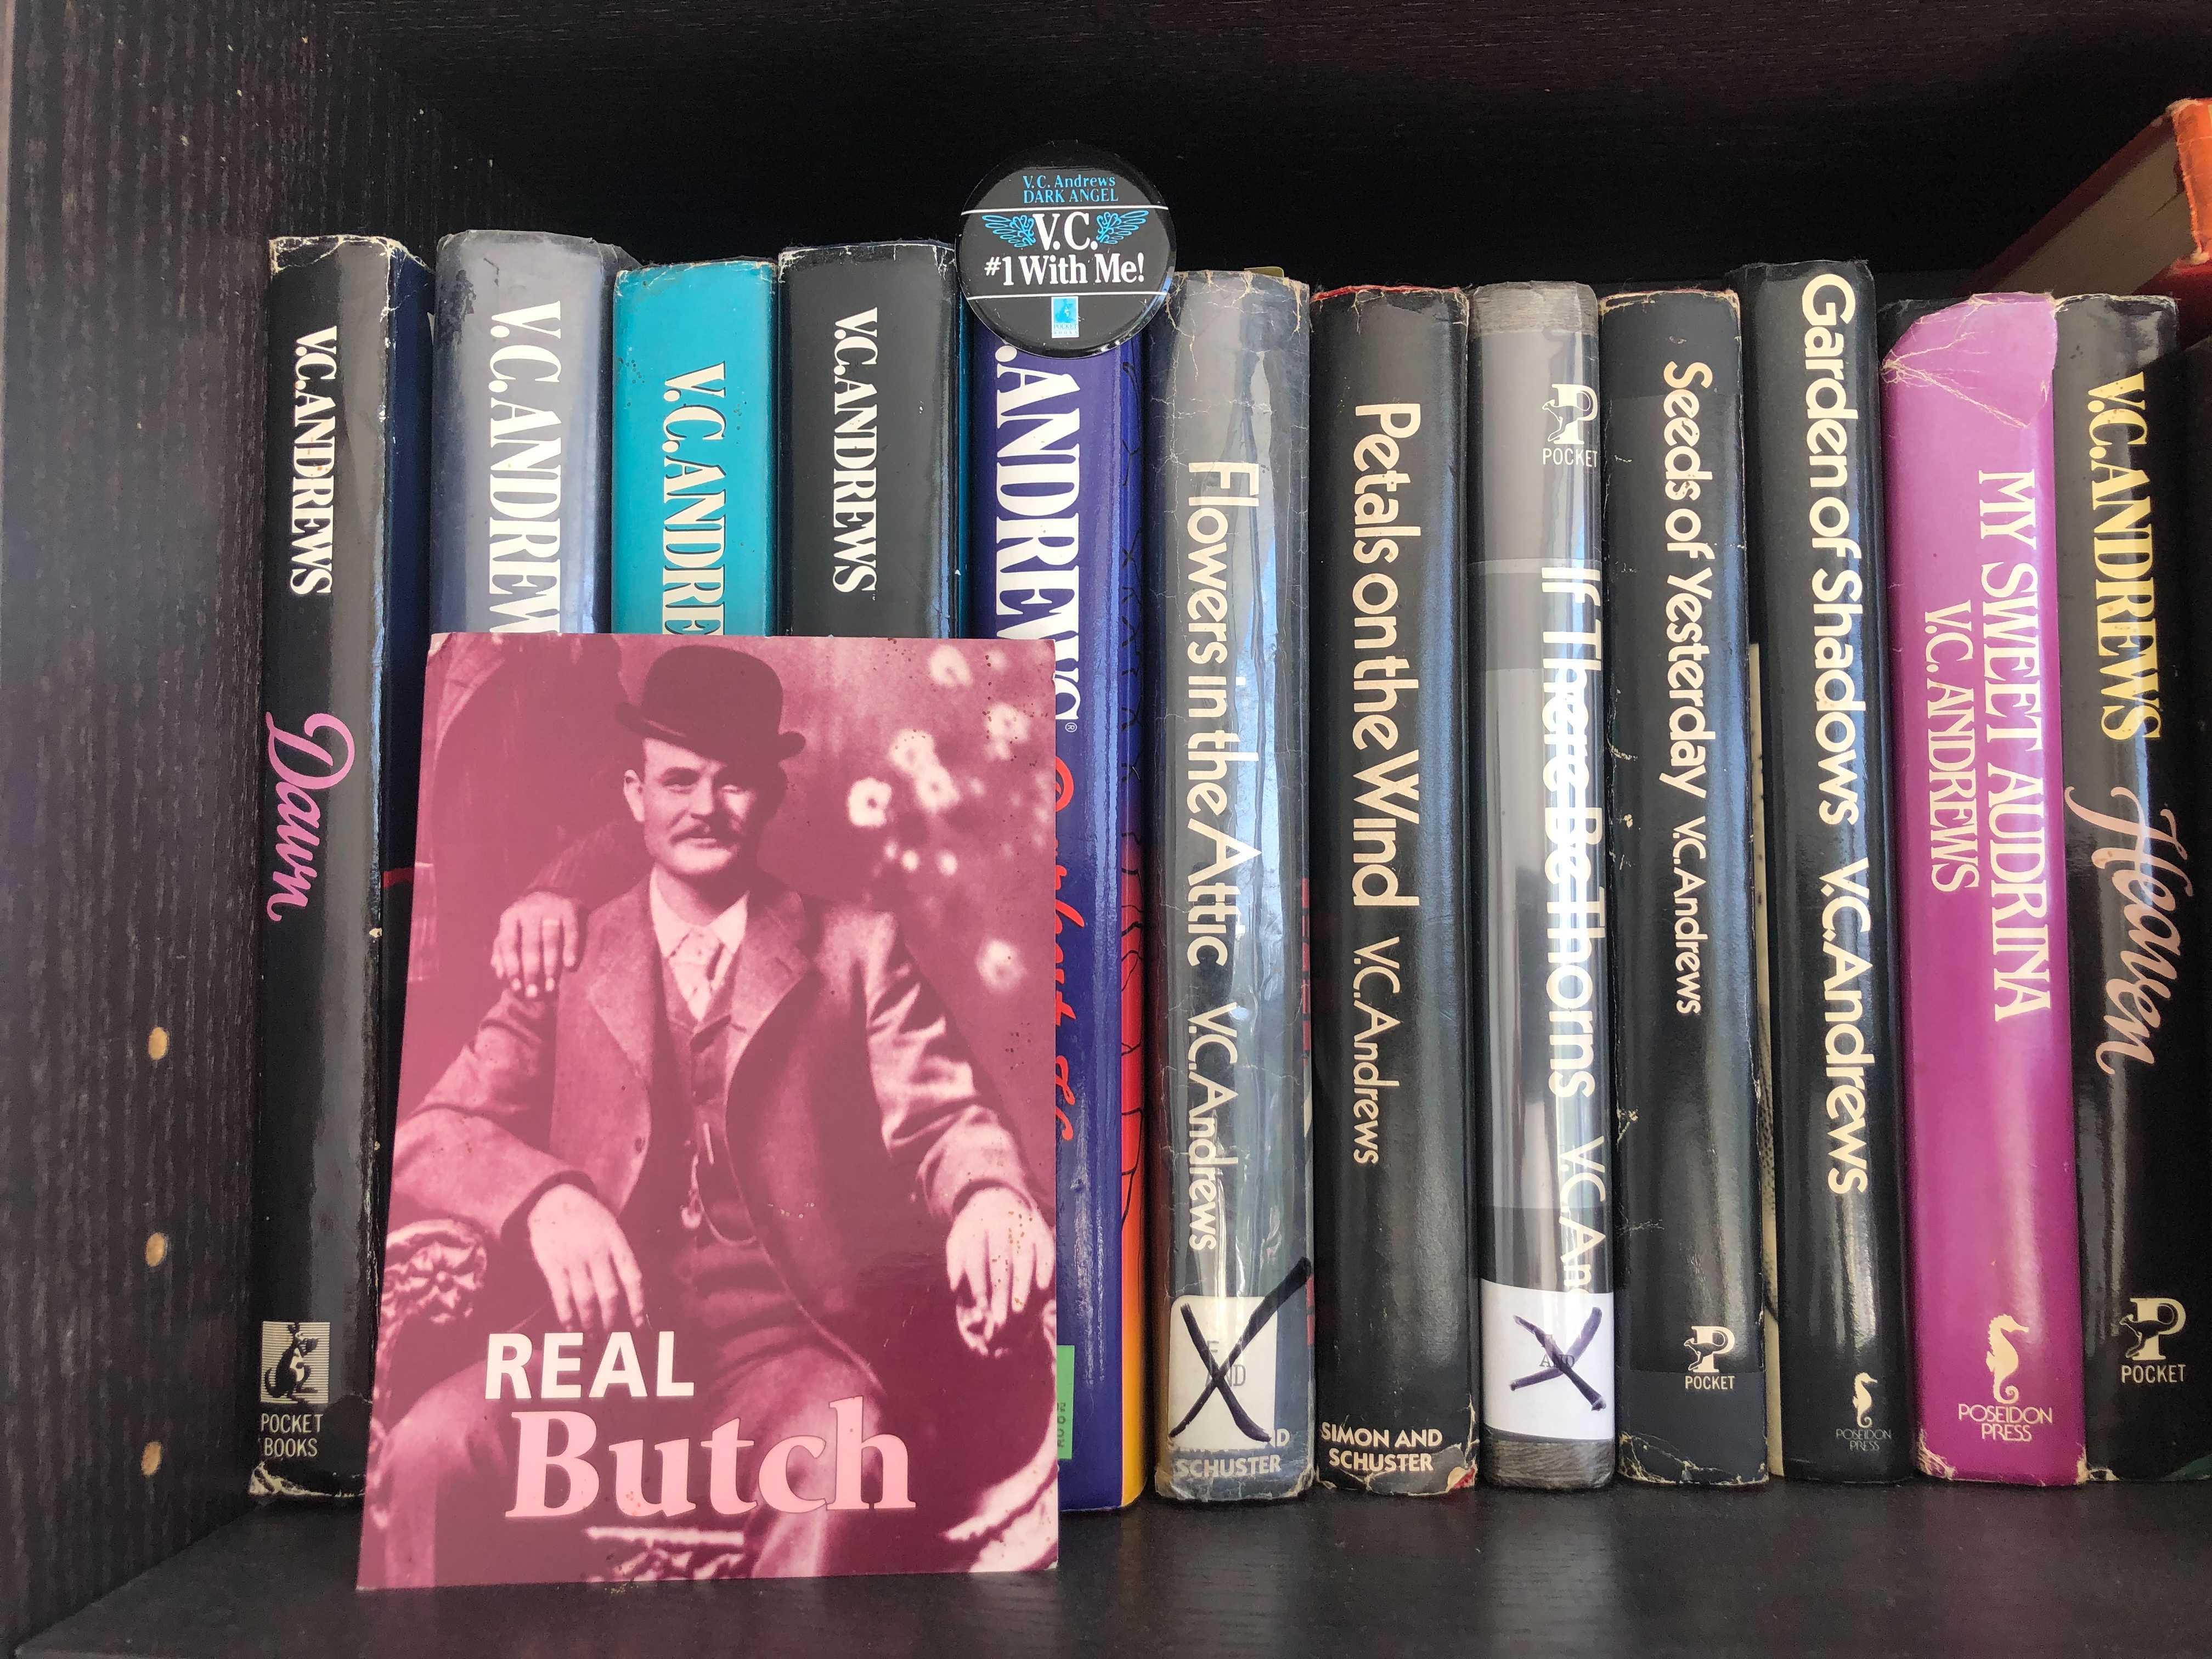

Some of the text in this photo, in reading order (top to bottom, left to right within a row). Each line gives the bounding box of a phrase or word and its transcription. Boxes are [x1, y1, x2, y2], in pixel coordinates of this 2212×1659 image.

[1023, 174, 1115, 189] V.C. Andrews
[1023, 188, 1118, 204] DARK ANGEL
[1032, 211, 1098, 251] V.C.
[984, 252, 1144, 286] #1 With Me!
[1802, 273, 1859, 488] Garden
[1663, 360, 1713, 501] Seeds
[1353, 403, 1421, 563] Petals
[1542, 448, 1598, 468] POCKET
[1666, 508, 1716, 560] of
[1809, 496, 1862, 559] of
[1187, 462, 1260, 664] Flowers
[1542, 567, 1601, 607] If
[1352, 573, 1398, 648] on
[1188, 676, 1246, 718] in
[1352, 656, 1419, 750] the
[1659, 567, 1716, 799] Yesterday
[1812, 568, 1866, 826] Shadows
[1978, 469, 2051, 1022] MY SWEET AUDRINA
[1187, 730, 1259, 816] the
[266, 712, 355, 922] Dawn
[1352, 749, 1420, 906] Wind
[1187, 818, 1262, 966] Attic
[2064, 785, 2193, 1075] Heaven
[1545, 887, 1606, 1098] Thorns
[484, 1330, 695, 1400] REAL
[1685, 1375, 1735, 1390] POCKET
[2121, 1364, 2186, 1384] POCKET
[261, 1413, 324, 1433] POCKET
[1322, 1421, 1443, 1448] SIMON AND
[1836, 1429, 1892, 1440] POSEIDON
[1957, 1403, 2053, 1425] POSEIDON
[1981, 1423, 2033, 1442] PRESS
[263, 1438, 318, 1458] BOOKS
[505, 1396, 917, 1518] Butch
[1176, 1454, 1282, 1478] SCHUSTER
[1329, 1448, 1434, 1473] SCHUSTER
[1849, 1440, 1881, 1452] PRESS
